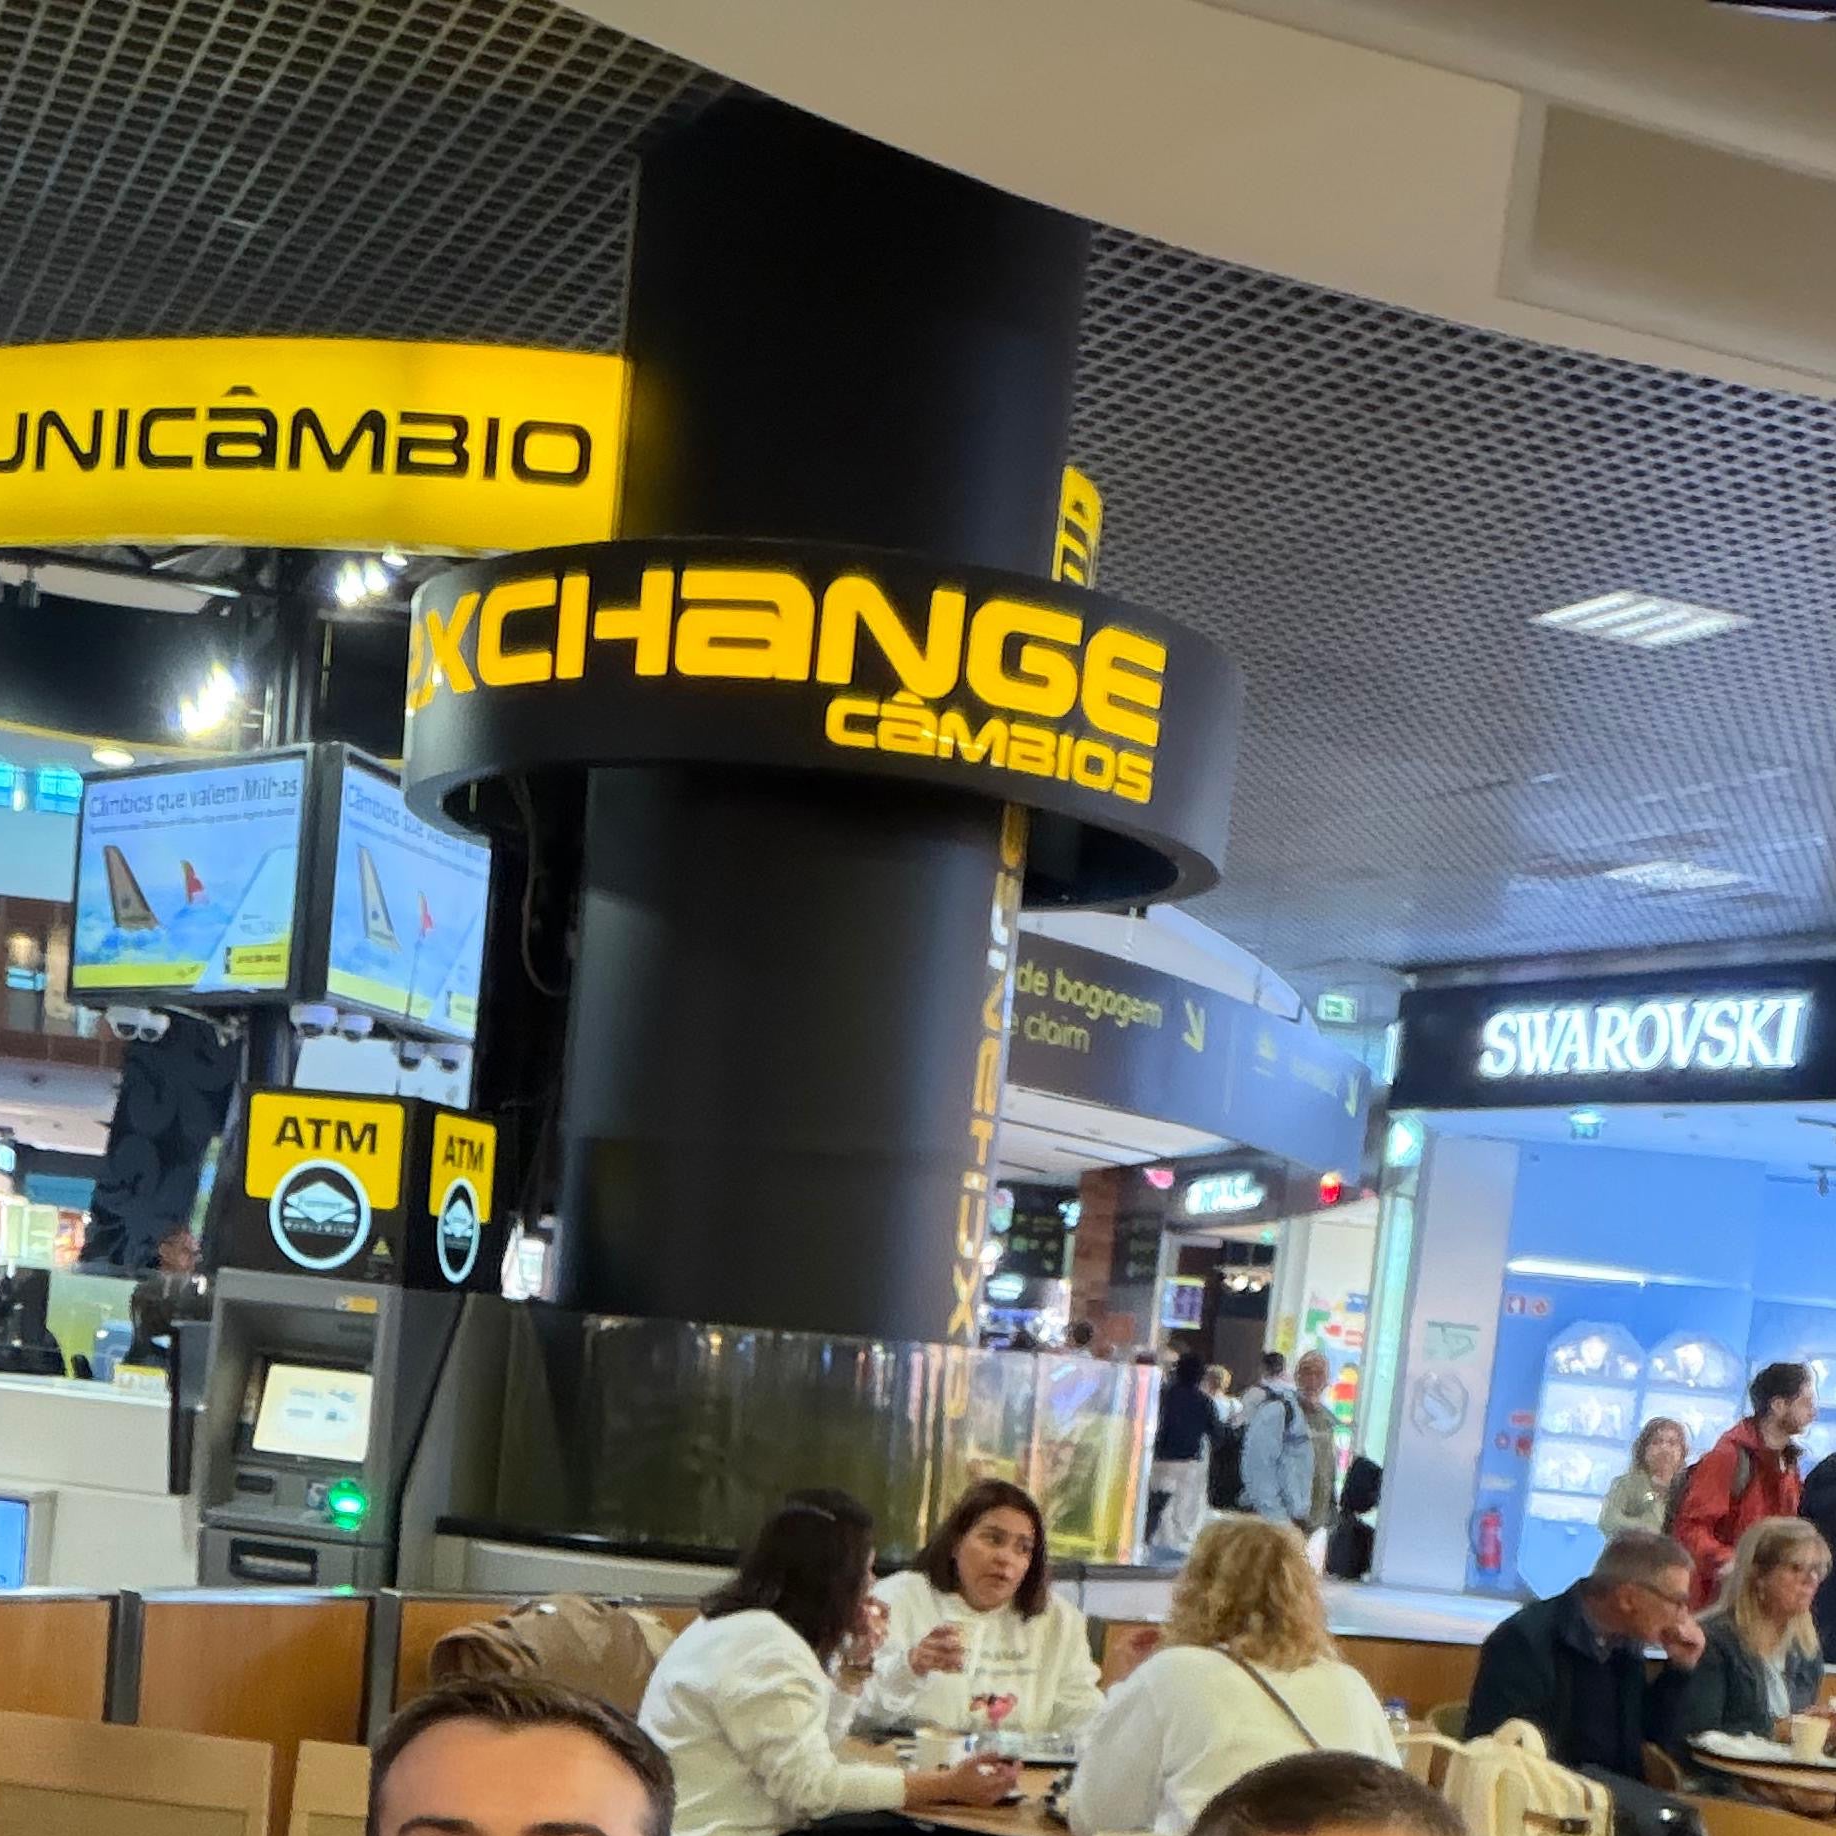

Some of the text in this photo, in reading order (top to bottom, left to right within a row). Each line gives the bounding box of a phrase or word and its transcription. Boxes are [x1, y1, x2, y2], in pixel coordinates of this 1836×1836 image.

[824, 690, 1154, 805] CÂMBIOS
[1478, 990, 1814, 1079] SWAROVSKI
[273, 1115, 379, 1155] ATM
[442, 1134, 487, 1174] ATM
